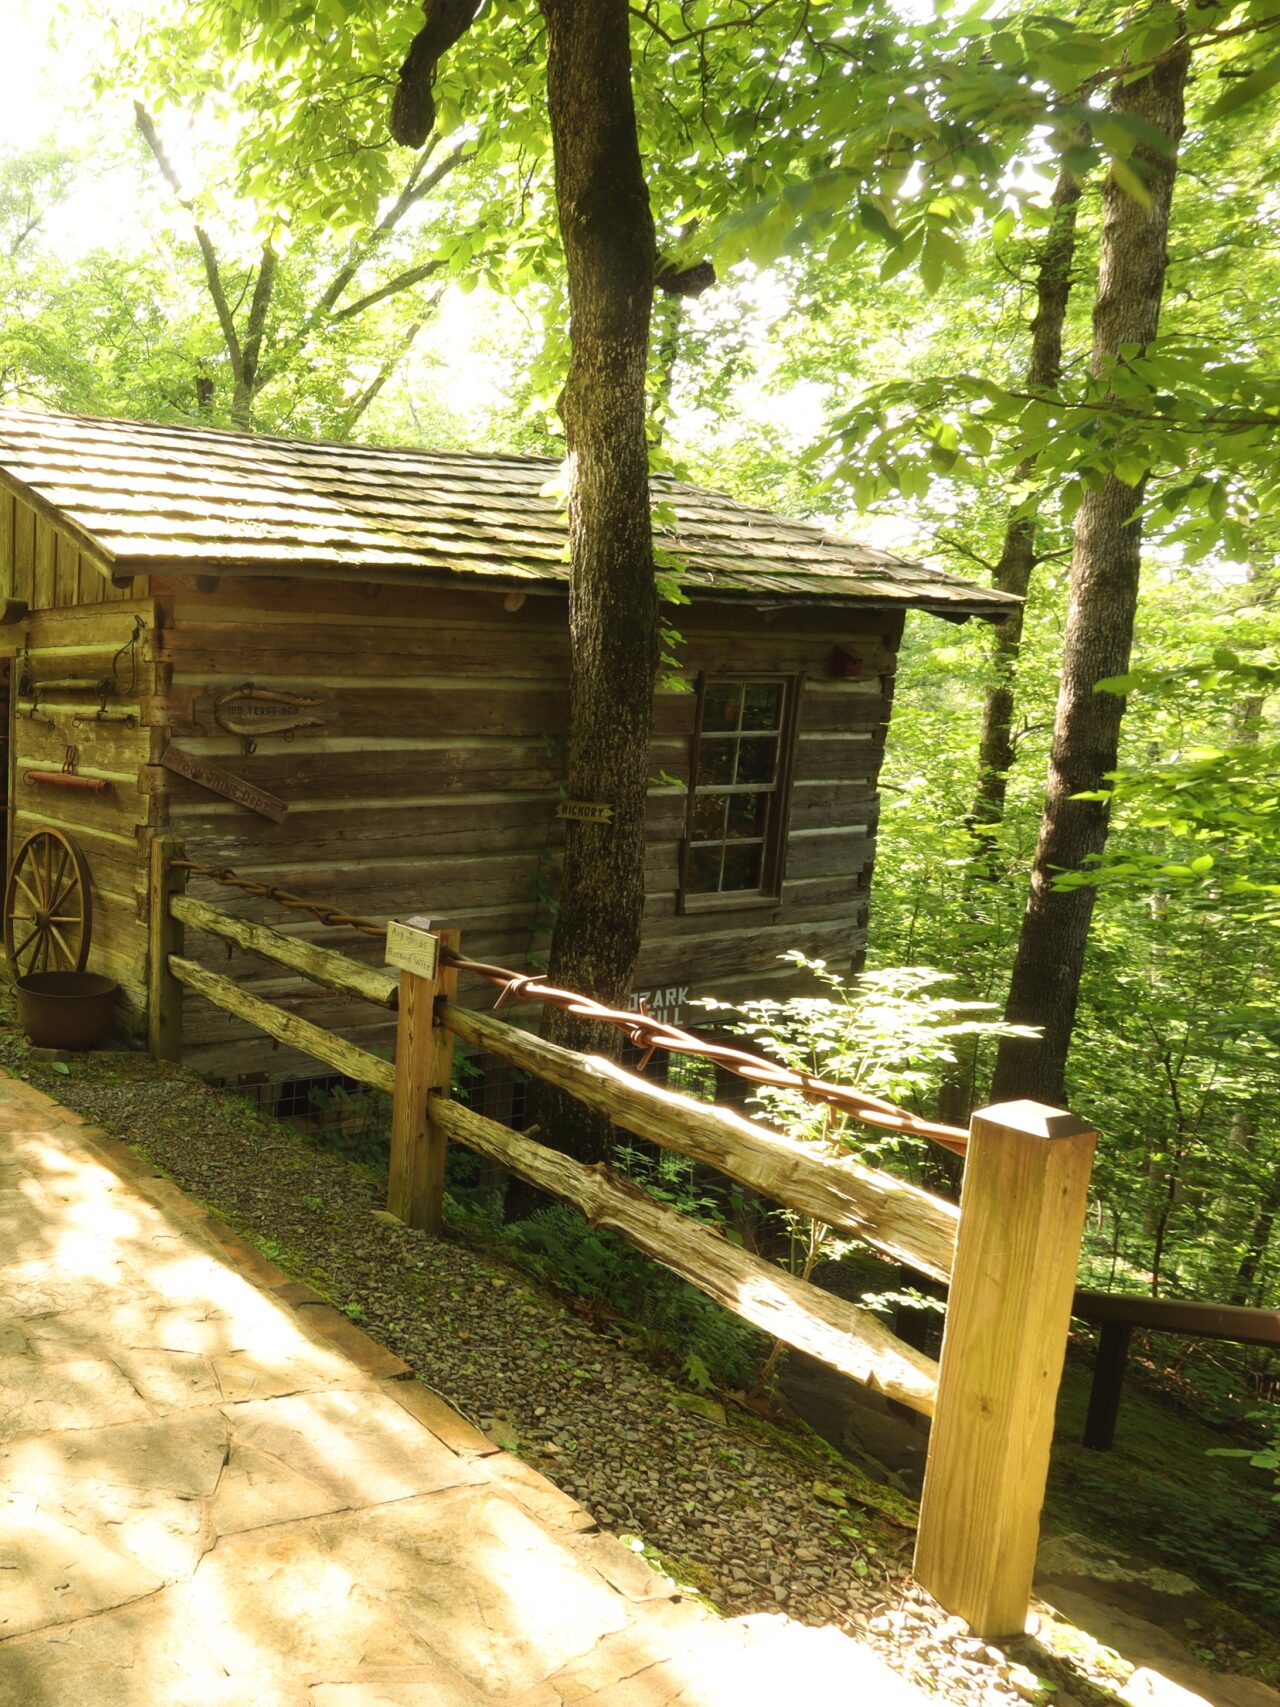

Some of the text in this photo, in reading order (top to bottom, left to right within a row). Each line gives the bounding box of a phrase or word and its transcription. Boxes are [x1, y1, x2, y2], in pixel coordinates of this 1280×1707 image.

[247, 705, 277, 716] YEARS
[562, 803, 604, 817] HICKORY
[628, 986, 689, 1011] OZARK
[647, 1007, 684, 1025] ILL
